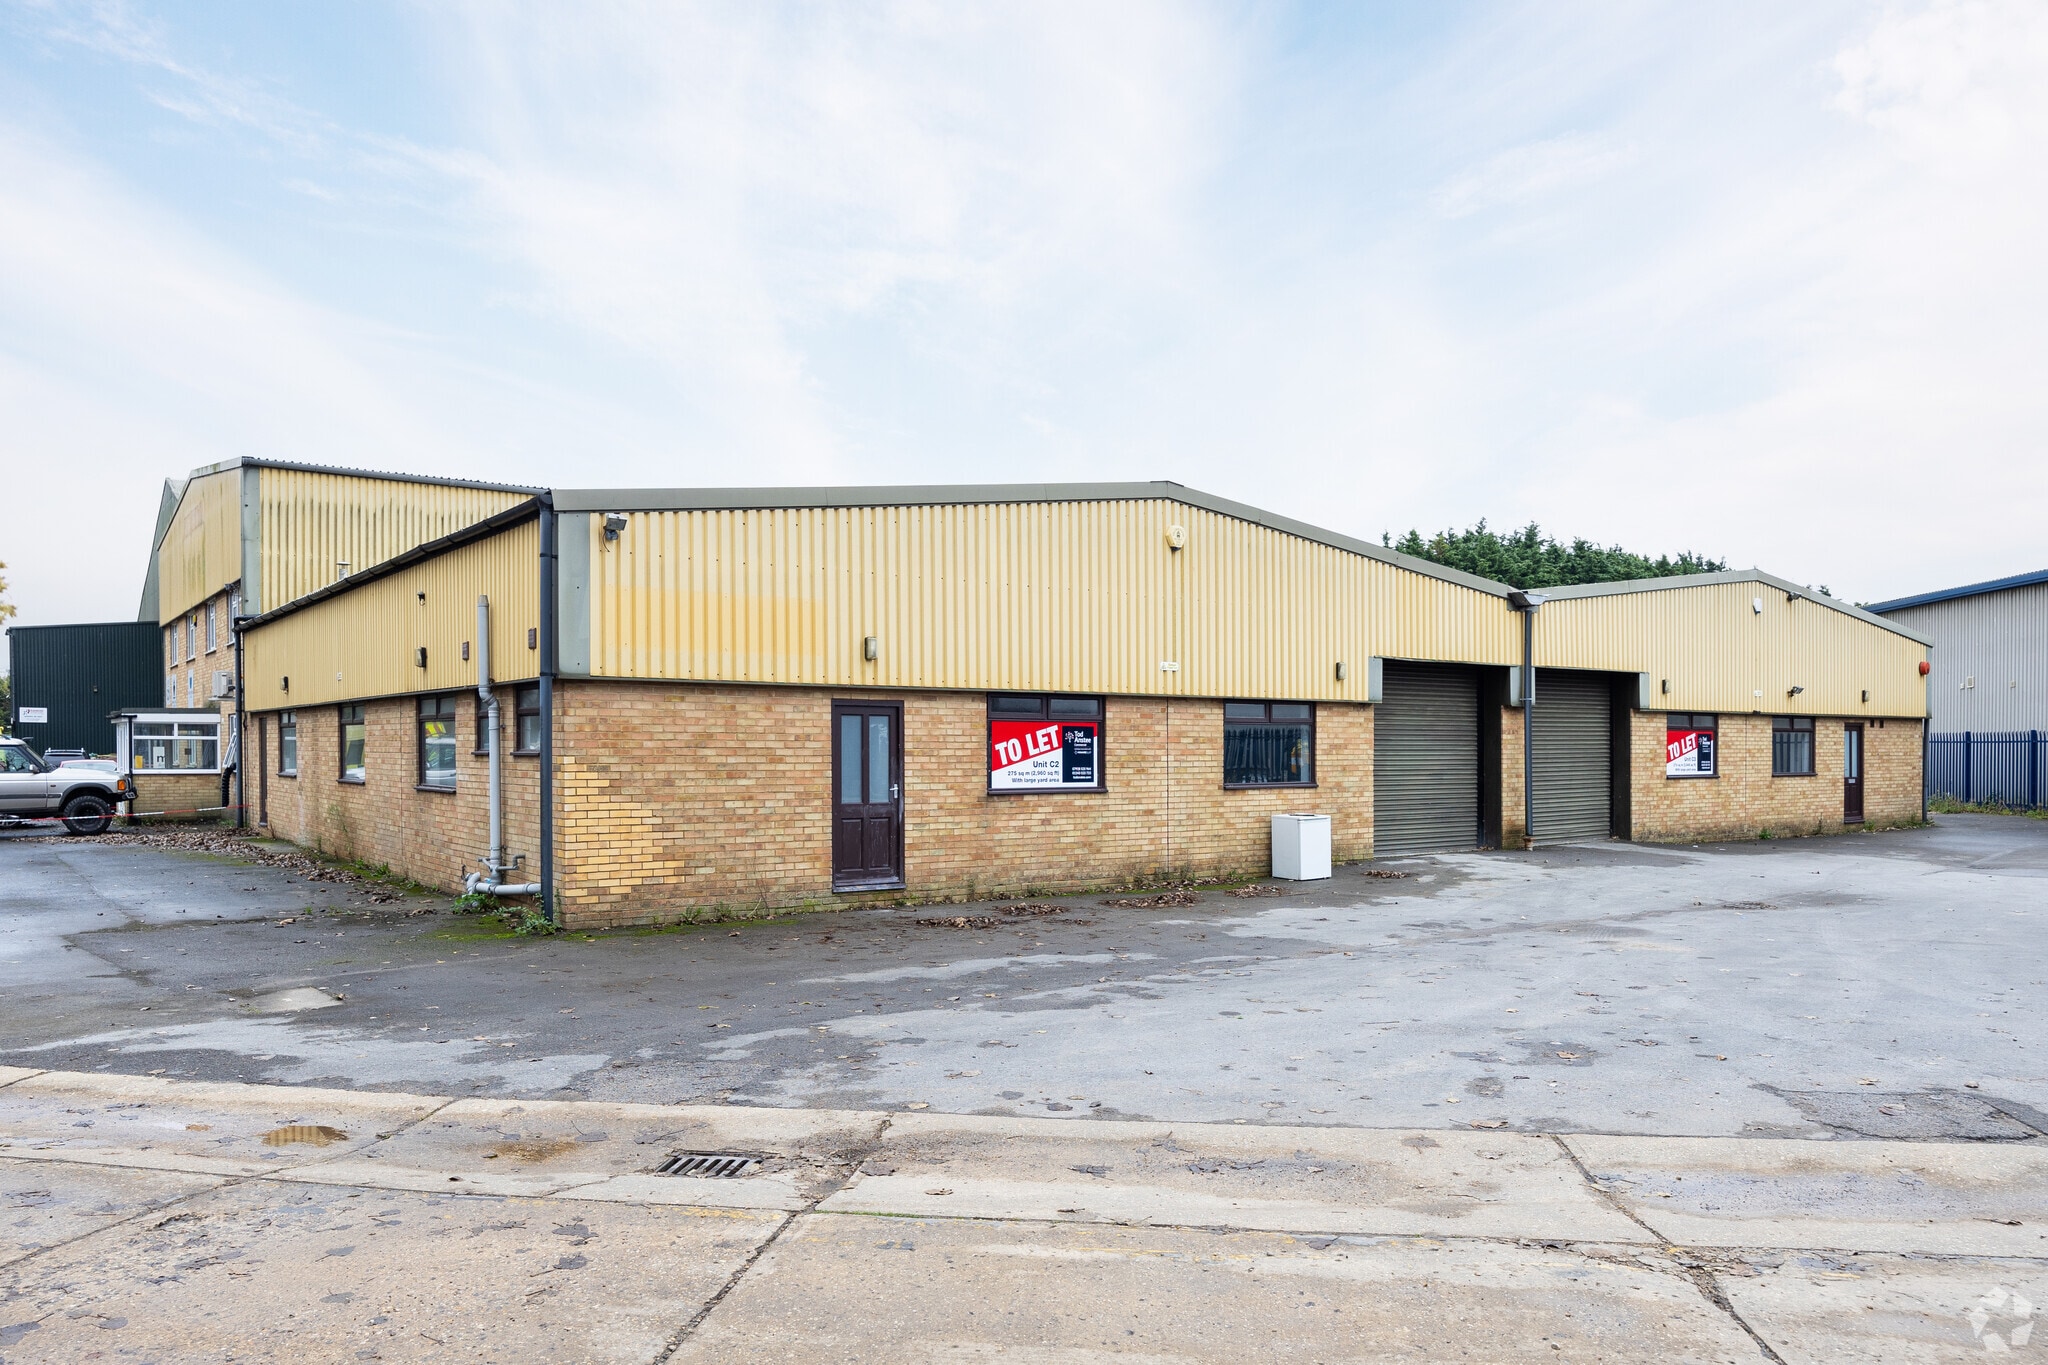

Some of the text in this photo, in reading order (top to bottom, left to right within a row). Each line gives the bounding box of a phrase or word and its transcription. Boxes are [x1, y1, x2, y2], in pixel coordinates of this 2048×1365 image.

[994, 724, 1059, 766] TO LET
[1668, 733, 1696, 760] TO LET
